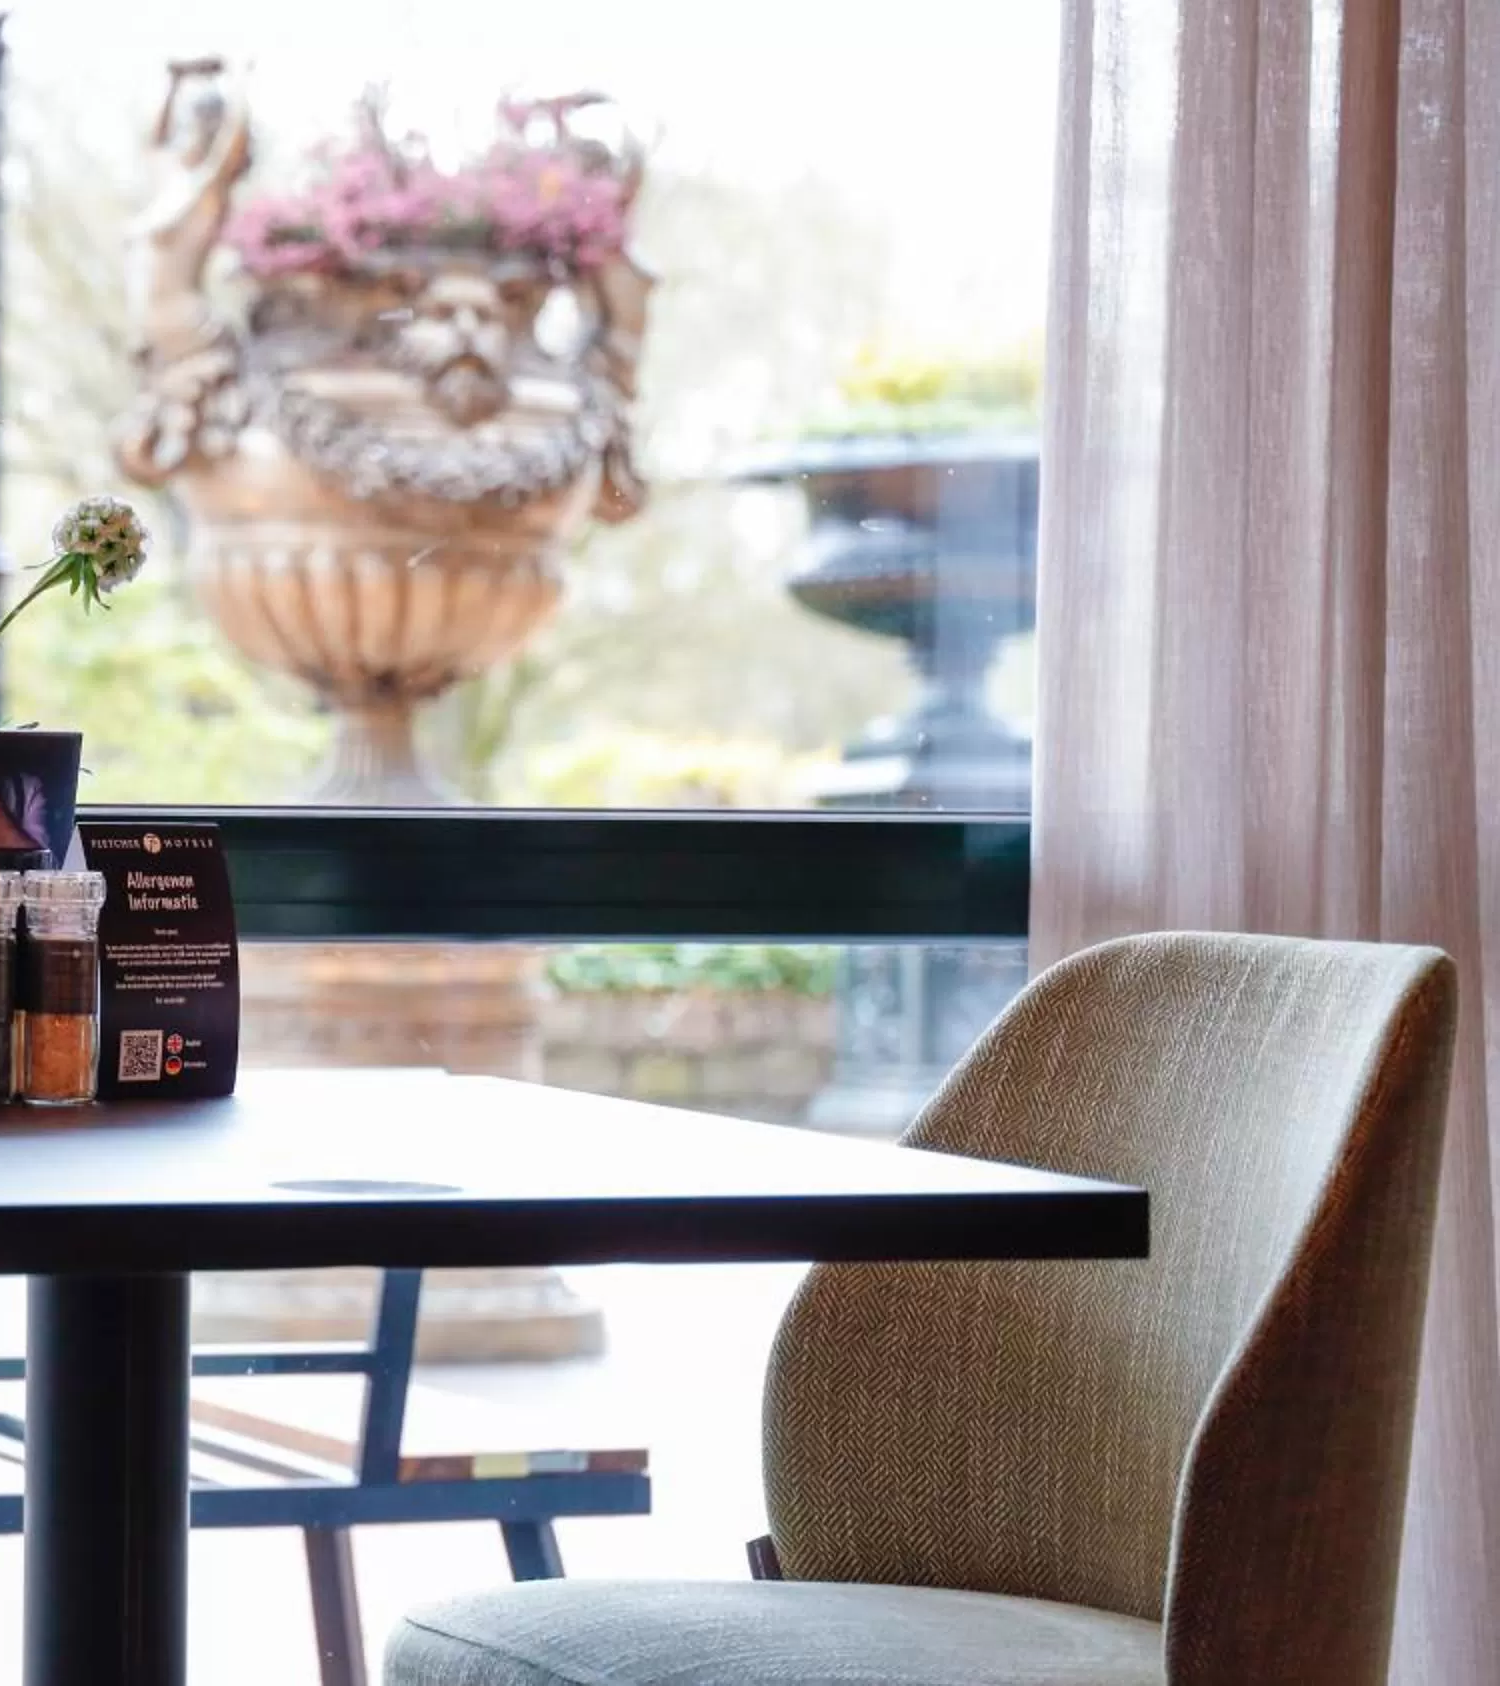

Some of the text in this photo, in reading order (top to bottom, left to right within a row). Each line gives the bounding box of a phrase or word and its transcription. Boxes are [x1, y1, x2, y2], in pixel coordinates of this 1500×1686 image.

[91, 838, 214, 849] FLETCHER HOTELS
[127, 871, 195, 891] Allergenen
[128, 892, 199, 911] Informatie
